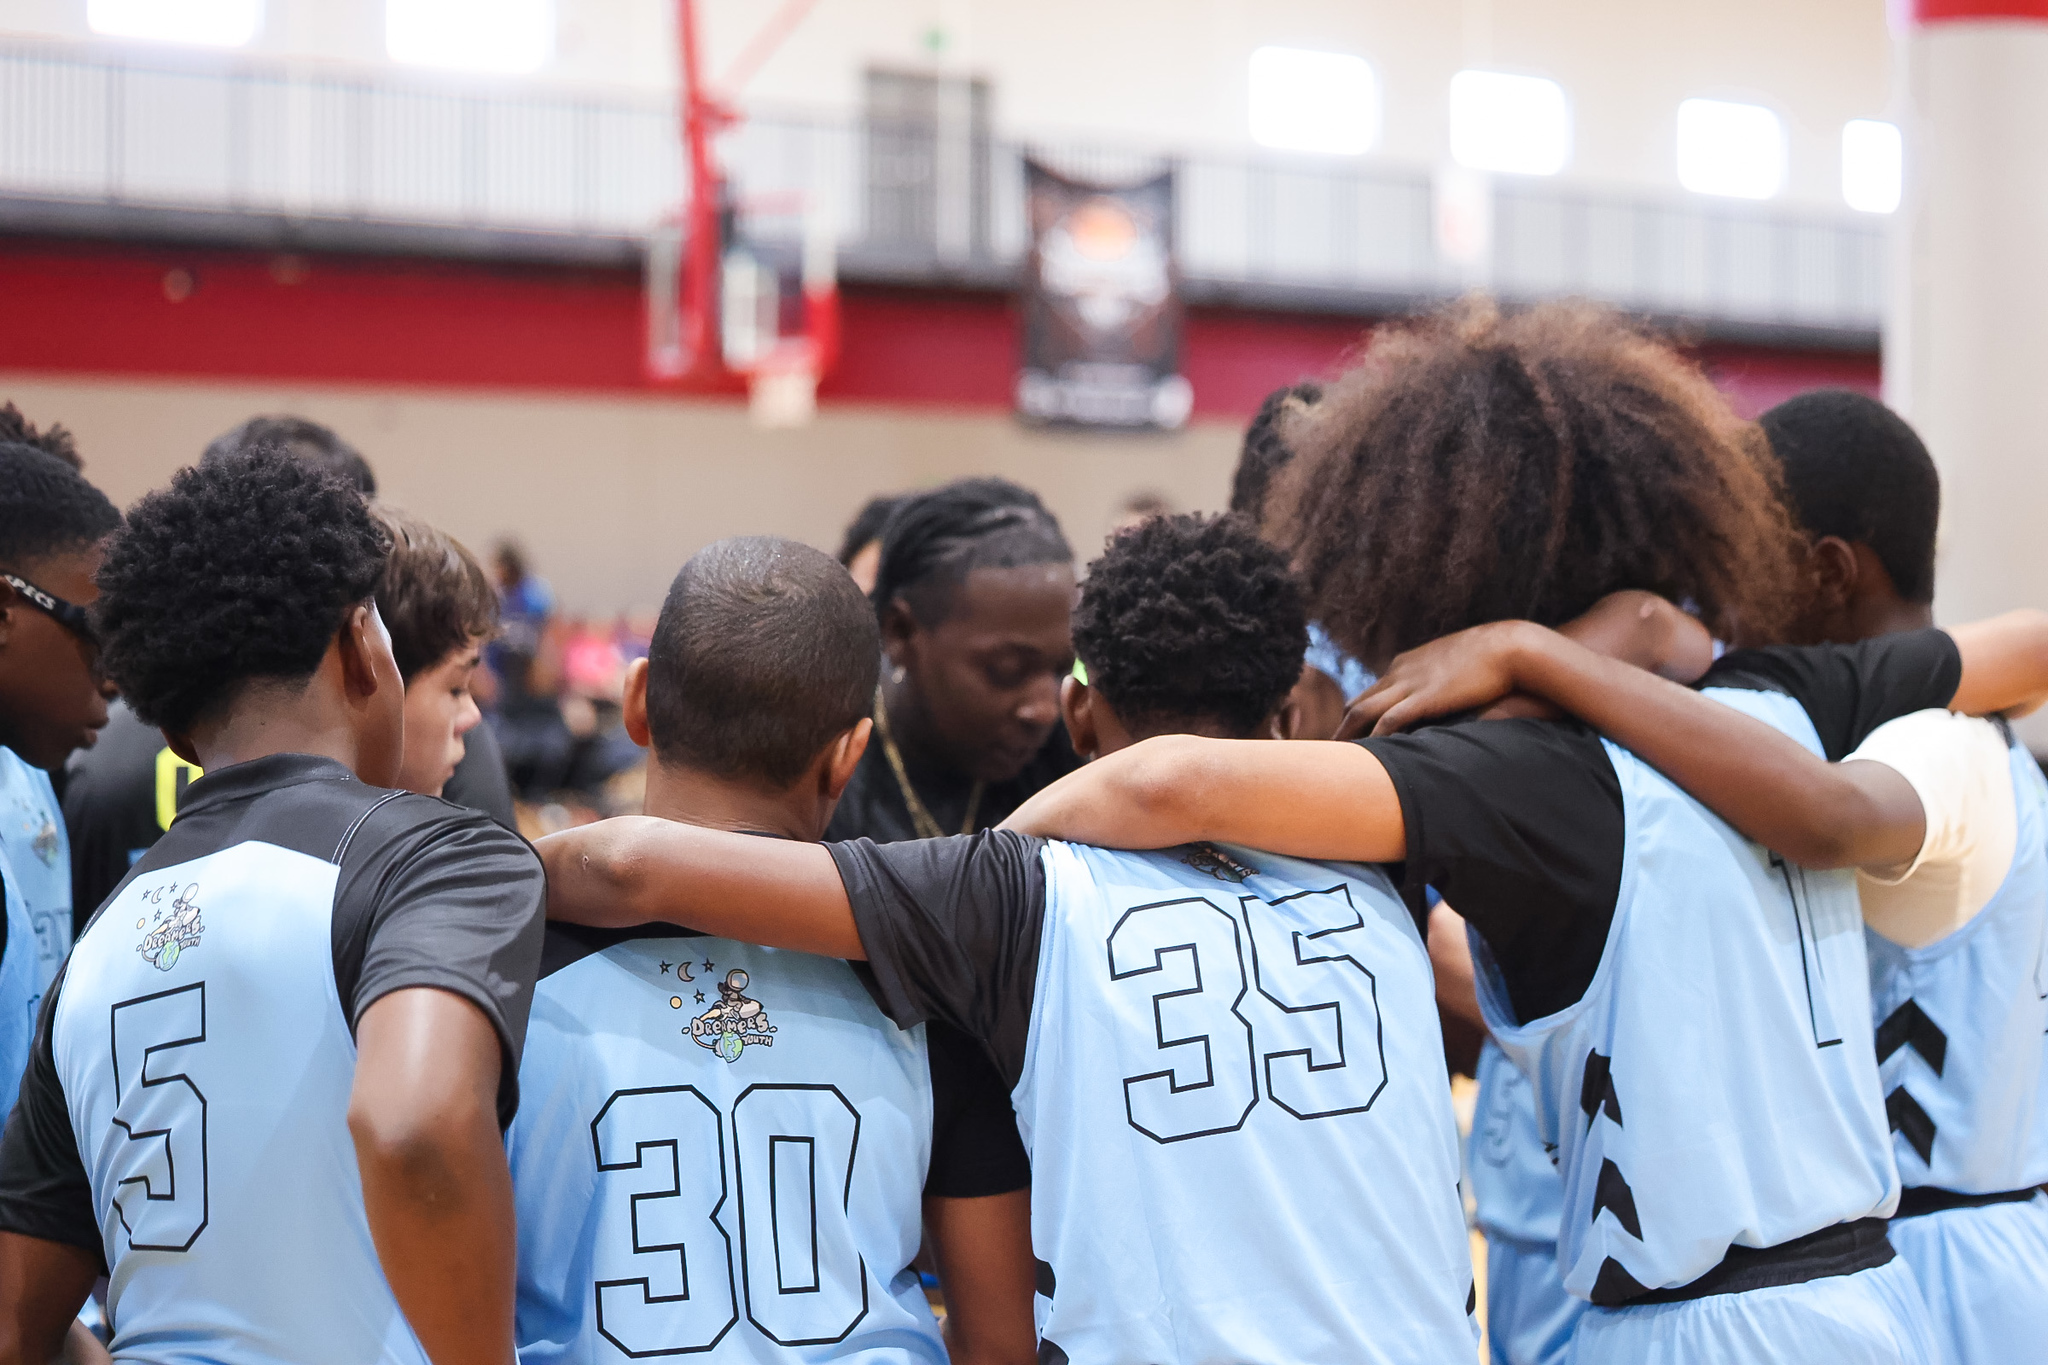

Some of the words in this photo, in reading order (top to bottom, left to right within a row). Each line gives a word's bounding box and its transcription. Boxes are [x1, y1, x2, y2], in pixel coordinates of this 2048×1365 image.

[111, 981, 208, 1252] 5
[741, 1033, 773, 1047] YOUTH
[1107, 883, 1388, 1144] 35
[591, 1083, 868, 1358] 30
